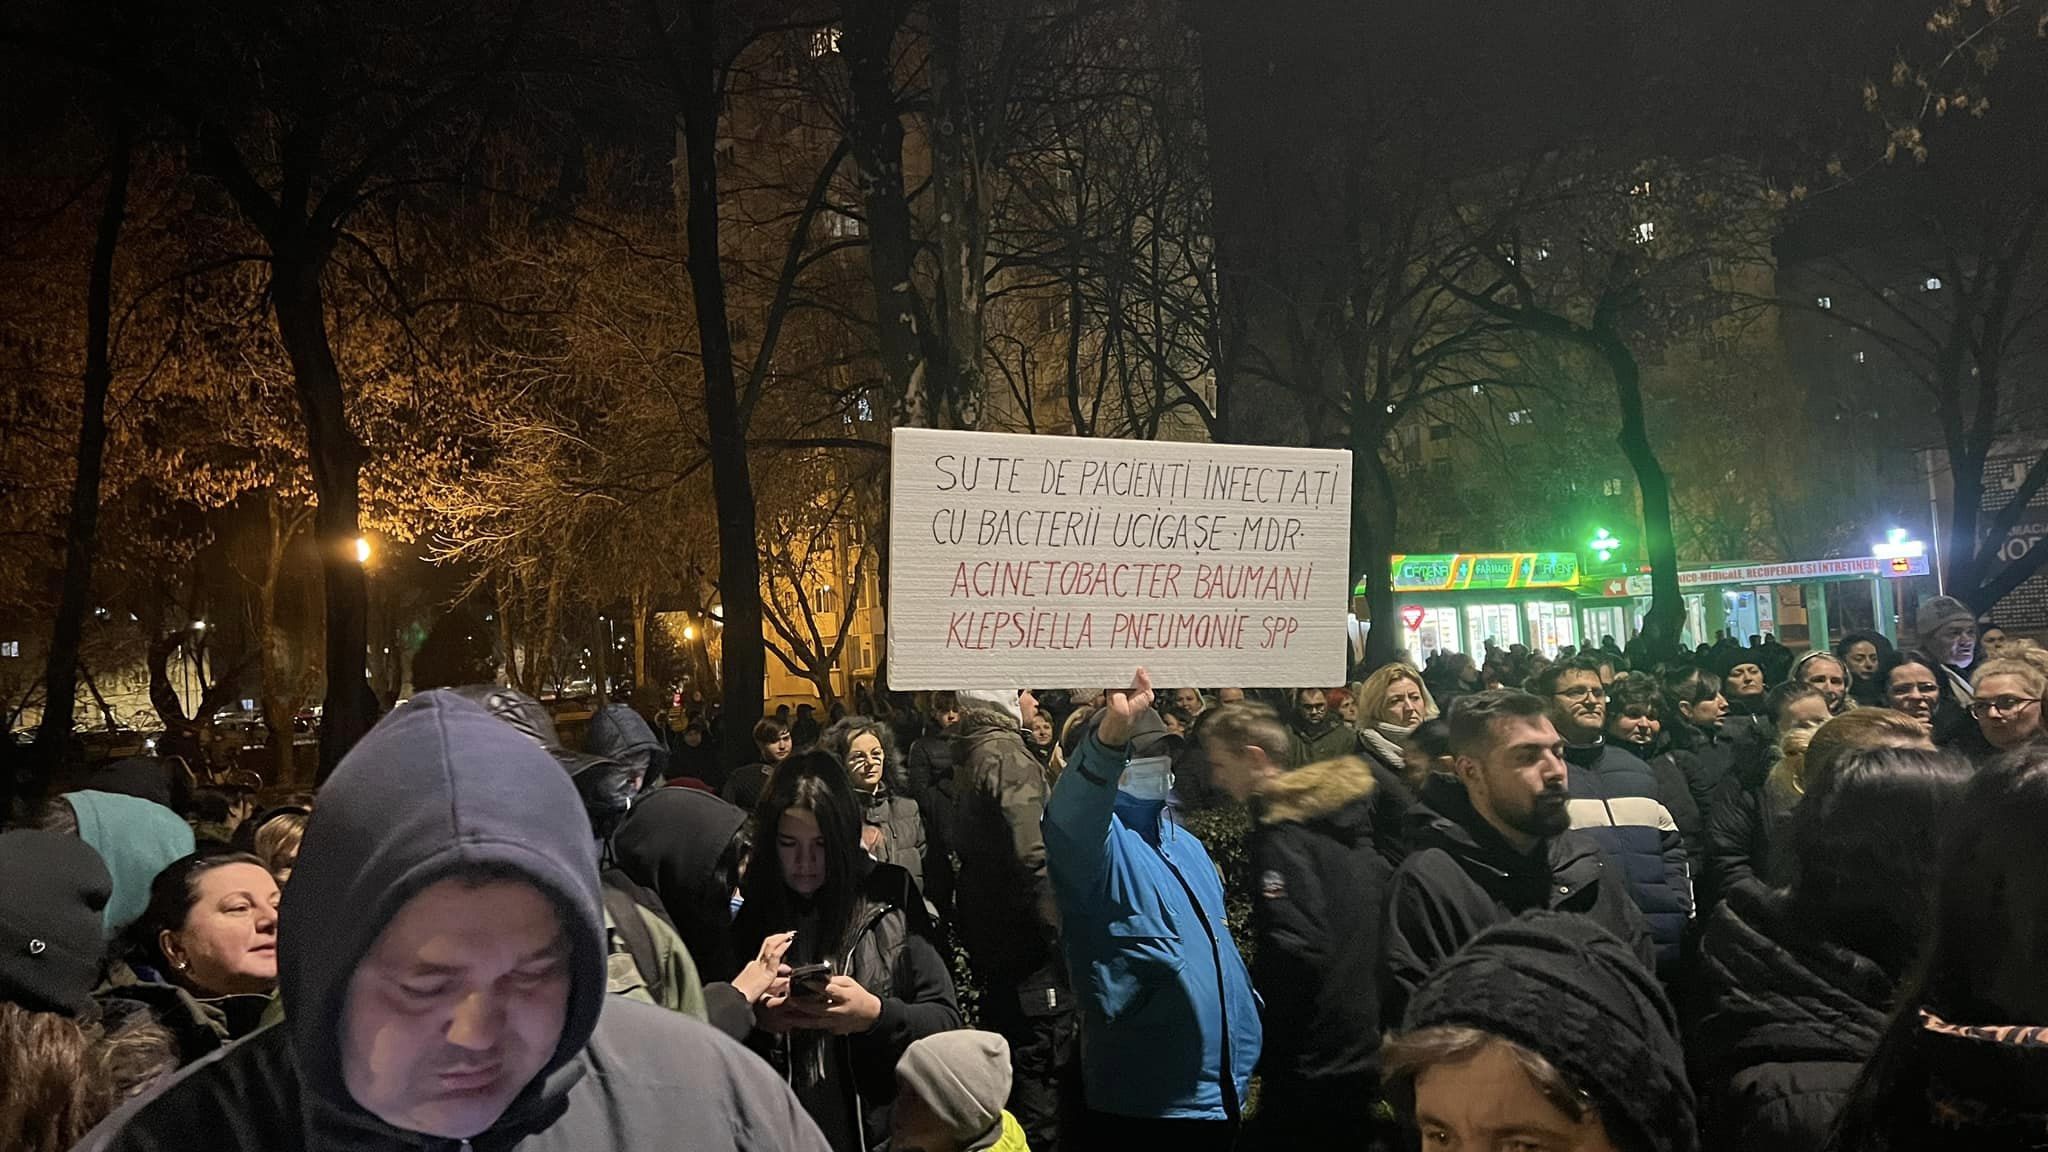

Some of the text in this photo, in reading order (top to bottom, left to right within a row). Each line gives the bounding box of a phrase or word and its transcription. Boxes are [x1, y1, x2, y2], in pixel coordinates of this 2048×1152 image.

[1041, 458, 1071, 495] DE
[932, 509, 965, 545] CU
[978, 507, 1100, 547] BACTERII
[950, 561, 1313, 601] ACINETOBACTER BAUMANI
[1746, 563, 1805, 579] RECUPERARE
[946, 606, 1298, 650] KLEPSIELLA PNEUMONIE SPP
